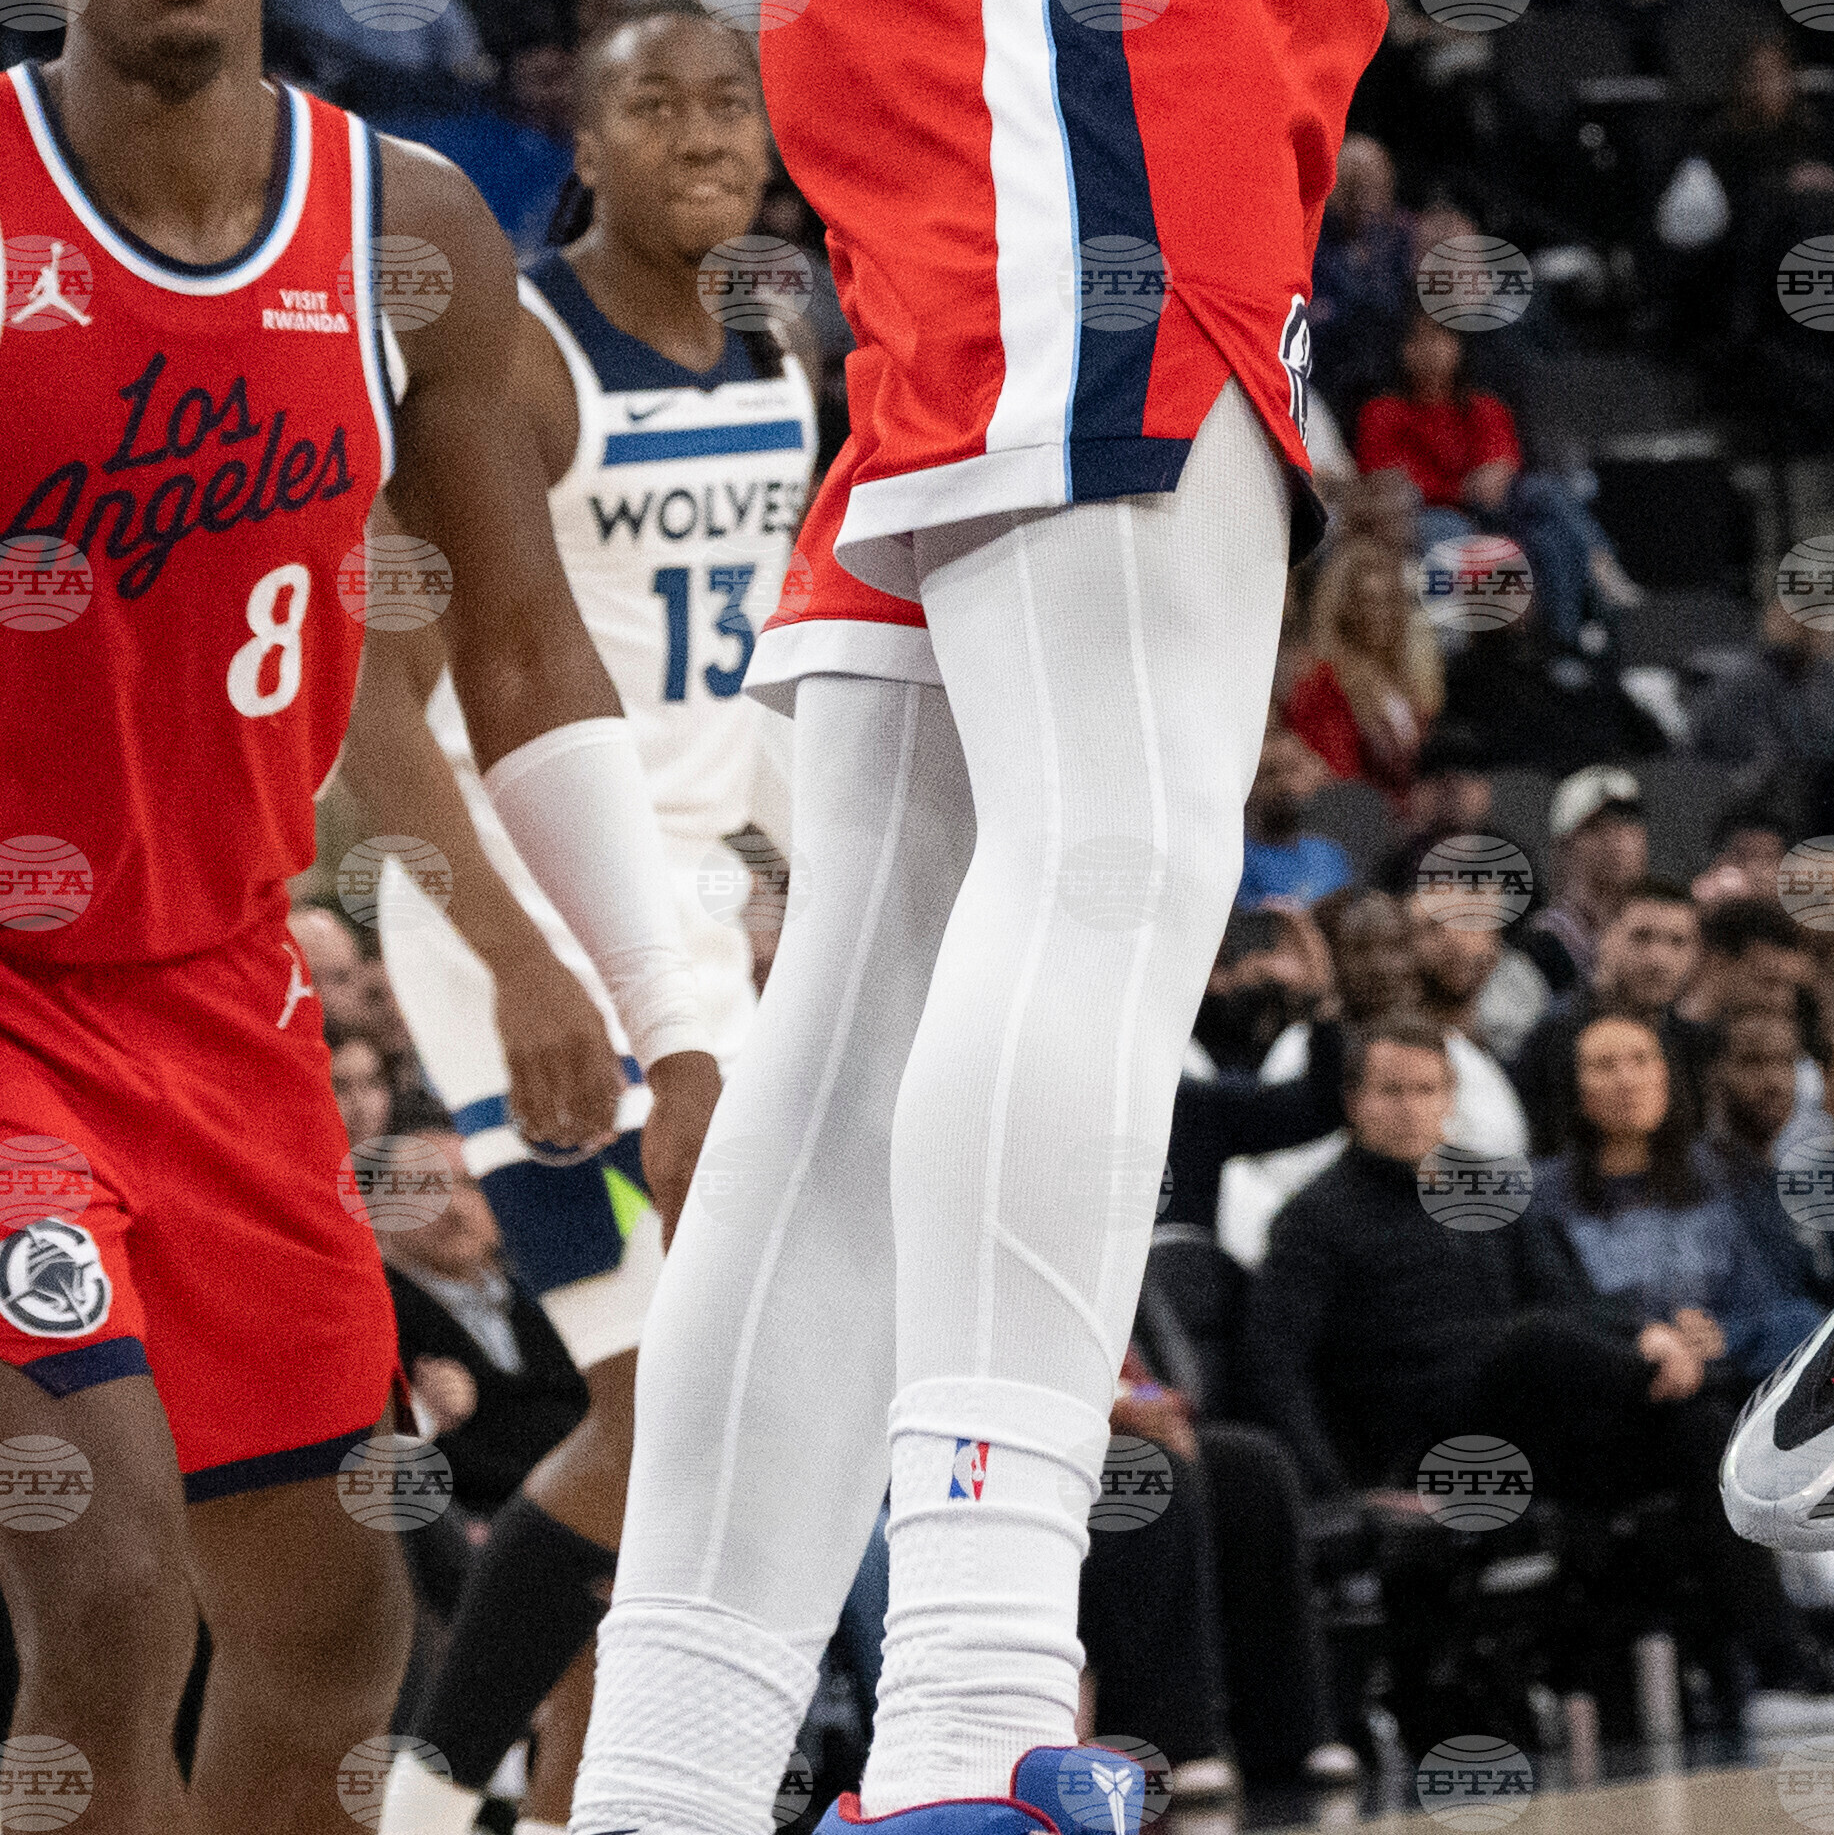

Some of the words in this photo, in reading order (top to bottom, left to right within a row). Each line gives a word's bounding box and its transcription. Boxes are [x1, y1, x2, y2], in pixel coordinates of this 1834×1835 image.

[261, 307, 350, 334] RWANDA
[279, 288, 328, 312] VISIT
[101, 351, 262, 475] Los
[0, 409, 354, 601] Angeles
[226, 562, 312, 719] 8
[653, 560, 757, 707] 13
